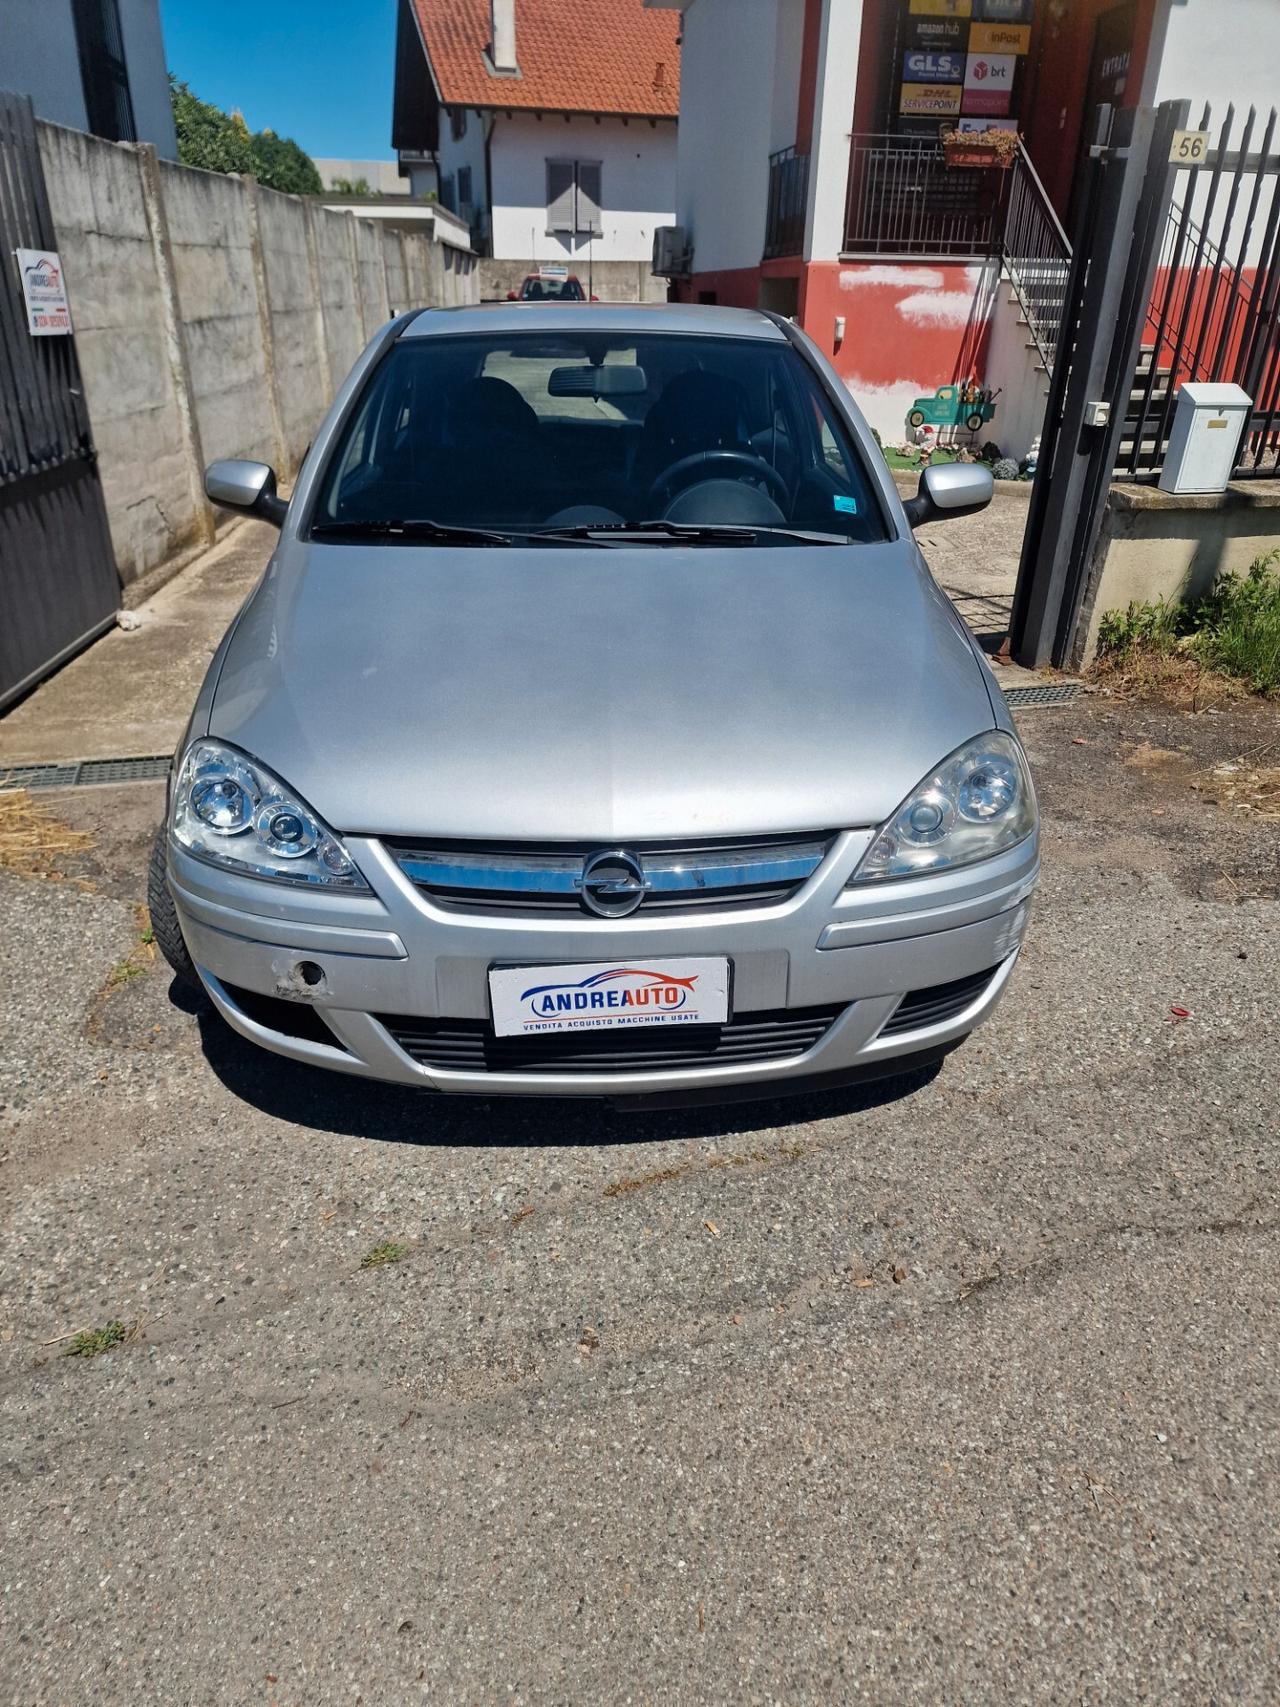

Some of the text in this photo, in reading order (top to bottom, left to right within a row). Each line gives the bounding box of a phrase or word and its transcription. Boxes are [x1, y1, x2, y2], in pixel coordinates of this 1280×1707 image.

[917, 22, 960, 35] amazon hub
[908, 55, 952, 71] GLS
[991, 66, 1006, 77] brt
[923, 89, 952, 97] DHL
[1179, 137, 1203, 158] 56
[541, 987, 678, 1012] ANDREAUTO
[523, 1014, 699, 1031] VENDITA ACQUISTO MACCHINE USATE
